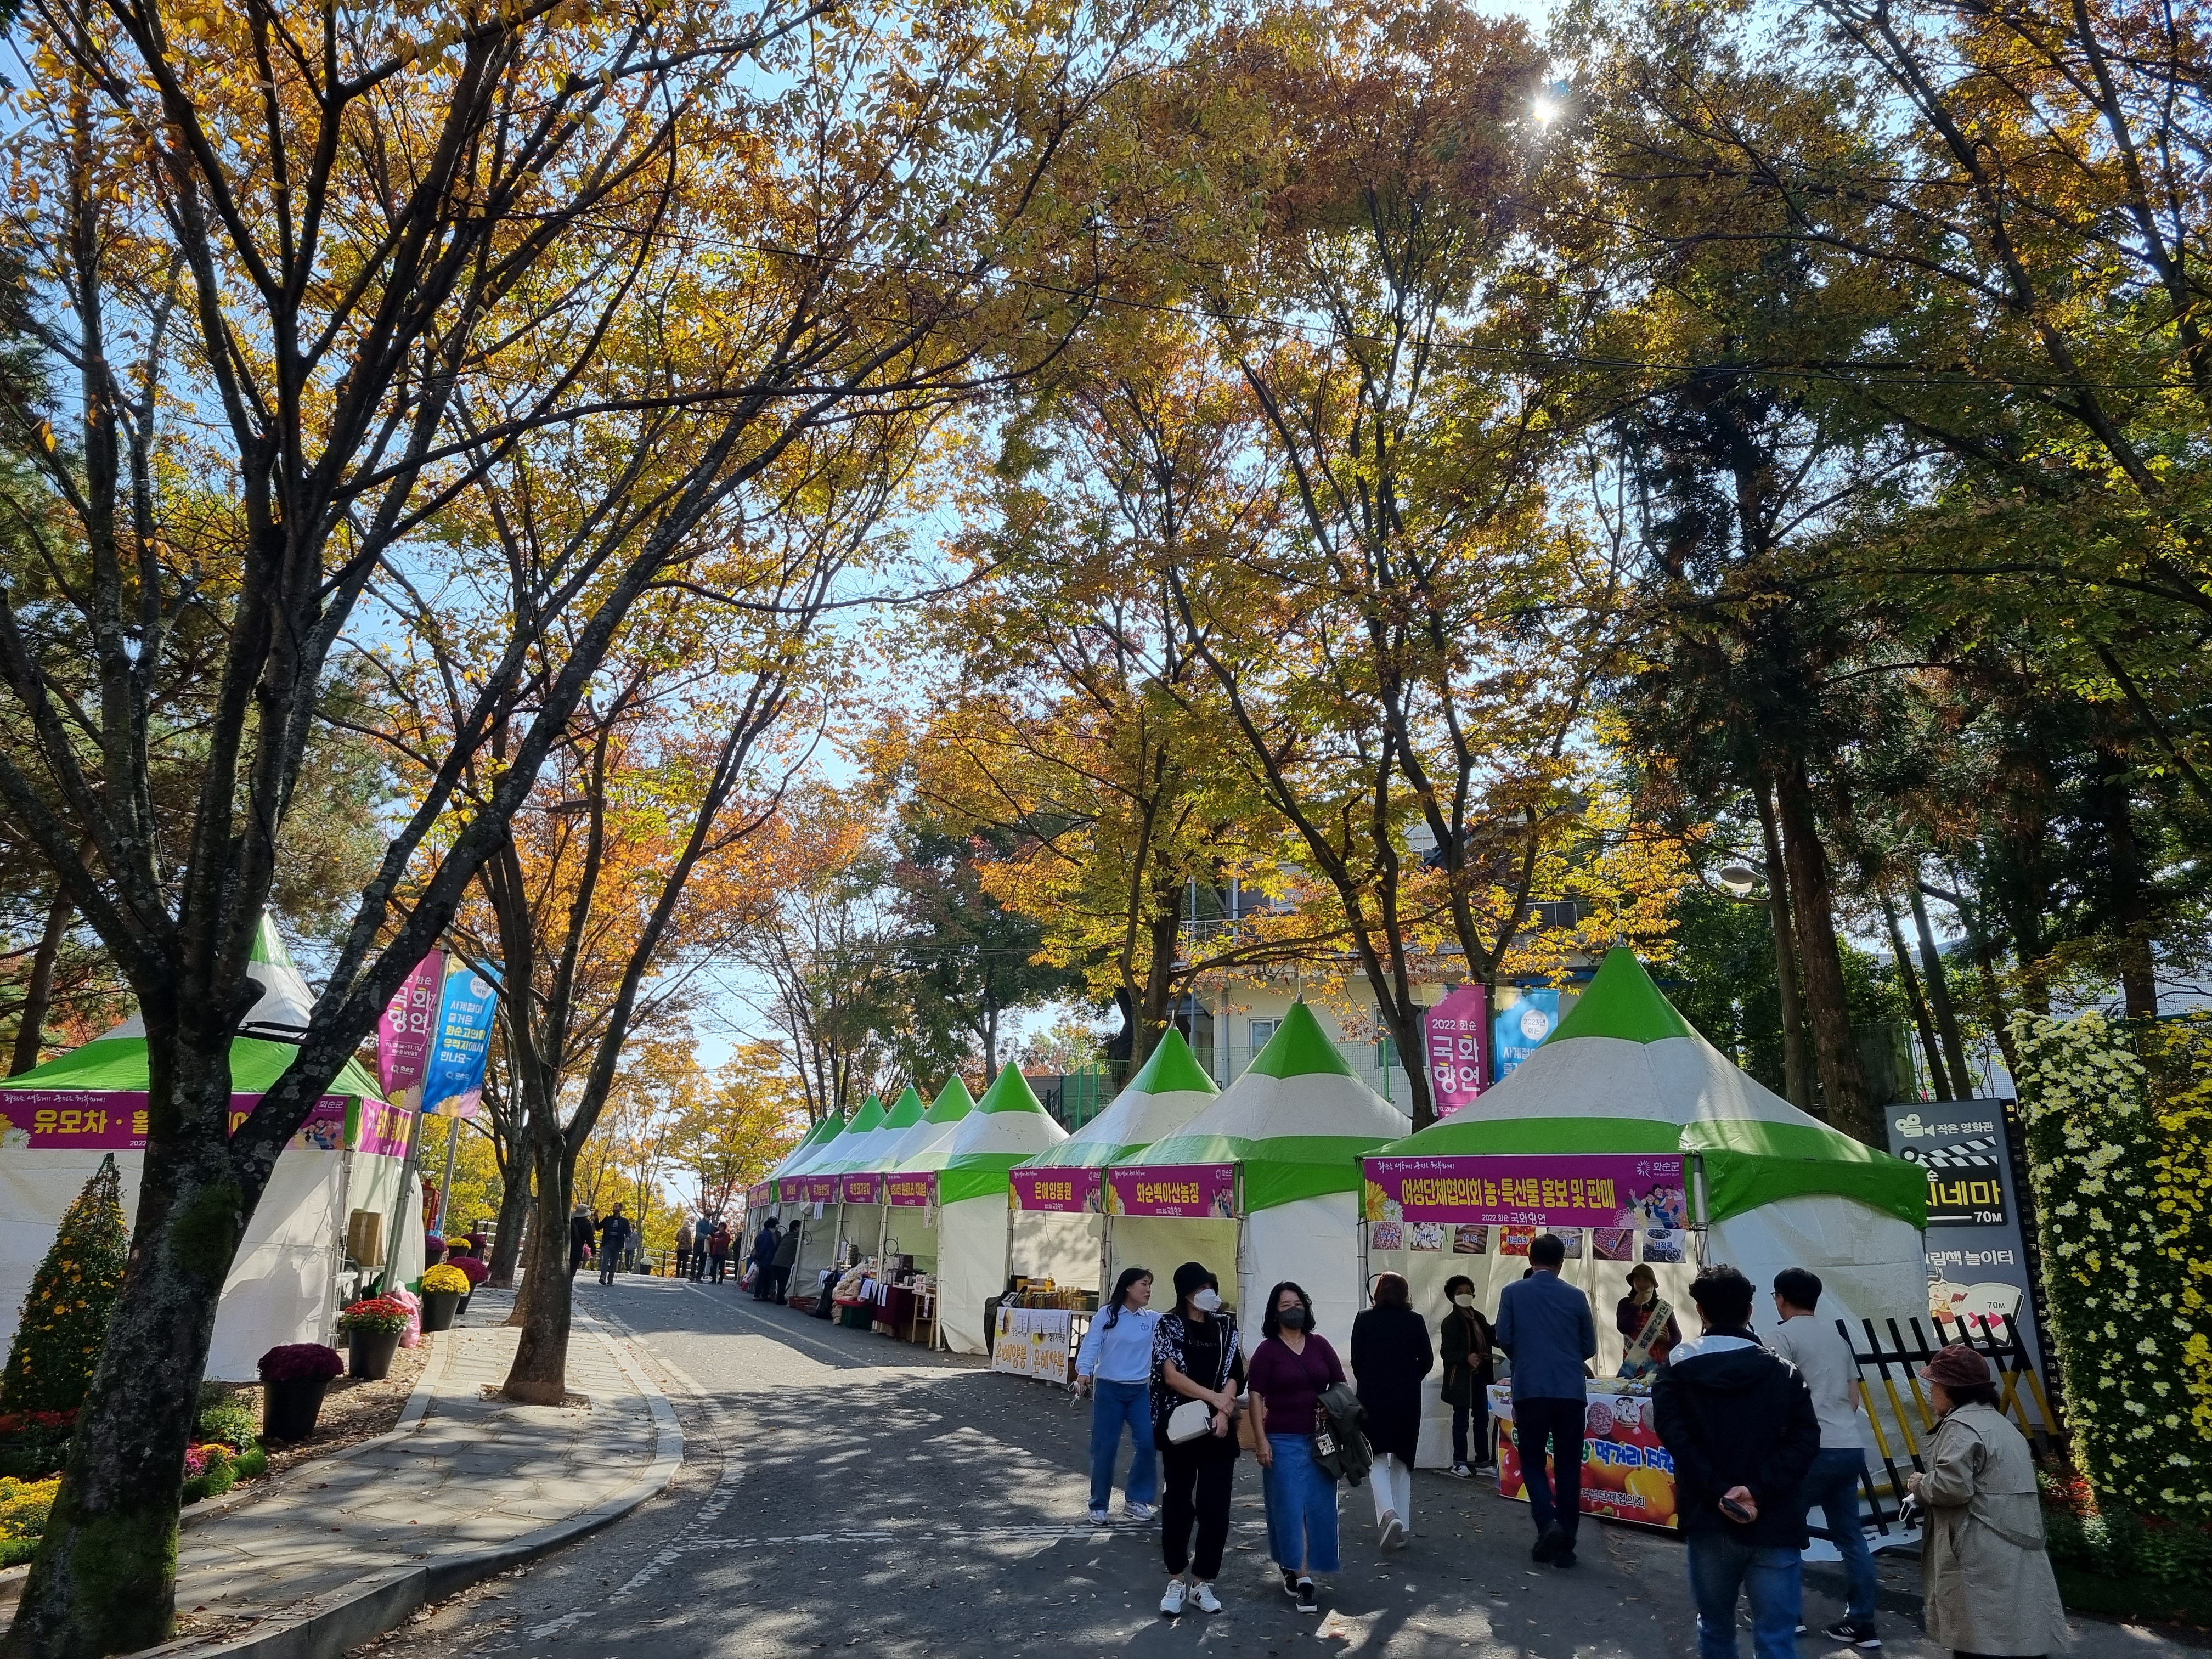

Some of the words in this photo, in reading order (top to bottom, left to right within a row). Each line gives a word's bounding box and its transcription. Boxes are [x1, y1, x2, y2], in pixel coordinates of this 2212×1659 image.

[416, 975, 432, 986] 화순
[450, 1000, 483, 1014] 사계절이
[387, 1006, 429, 1037] 향연
[447, 1012, 473, 1025] 즐거운
[1432, 1019, 1456, 1030] 2022
[1459, 1019, 1477, 1031] 화순
[1523, 1018, 1546, 1026] 2023년
[1528, 1027, 1541, 1035] 에는
[443, 1037, 484, 1053] 유적지에서
[1432, 1035, 1479, 1063] 국화
[440, 1051, 472, 1064] 만나요~
[1503, 1046, 1536, 1059] 사계절
[1434, 1062, 1481, 1094] 향연
[319, 1100, 343, 1109] 화순군
[33, 1109, 108, 1134] 유모차
[1937, 1123, 1959, 1135] 작은
[1960, 1121, 1994, 1134] 영화관
[1653, 1161, 1680, 1172] 화순군
[1926, 1169, 1939, 1182] 순
[1035, 1181, 1072, 1201] 은혜양봉원
[1136, 1182, 1200, 1204] 화순백아산농장
[1401, 1177, 1483, 1206] 여성단체협의회
[1483, 1177, 1540, 1207] 농·특산물
[1541, 1178, 1570, 1207] 홍보
[1570, 1178, 1587, 1209] 및
[1587, 1178, 1617, 1209] 판매
[1510, 1211, 1547, 1225] 국화향연
[1974, 1211, 2002, 1223] 70M
[1463, 1234, 1478, 1243] 더덕
[1506, 1235, 1529, 1245] 파프리카
[1561, 1238, 1575, 1247] 가루
[1654, 1241, 1674, 1251] 검정콩
[1964, 1249, 2015, 1266] 놀이터
[1987, 1301, 2005, 1310] 70M
[995, 1341, 1027, 1369] 은혜양봉
[1593, 1440, 1643, 1467] 먹거리
